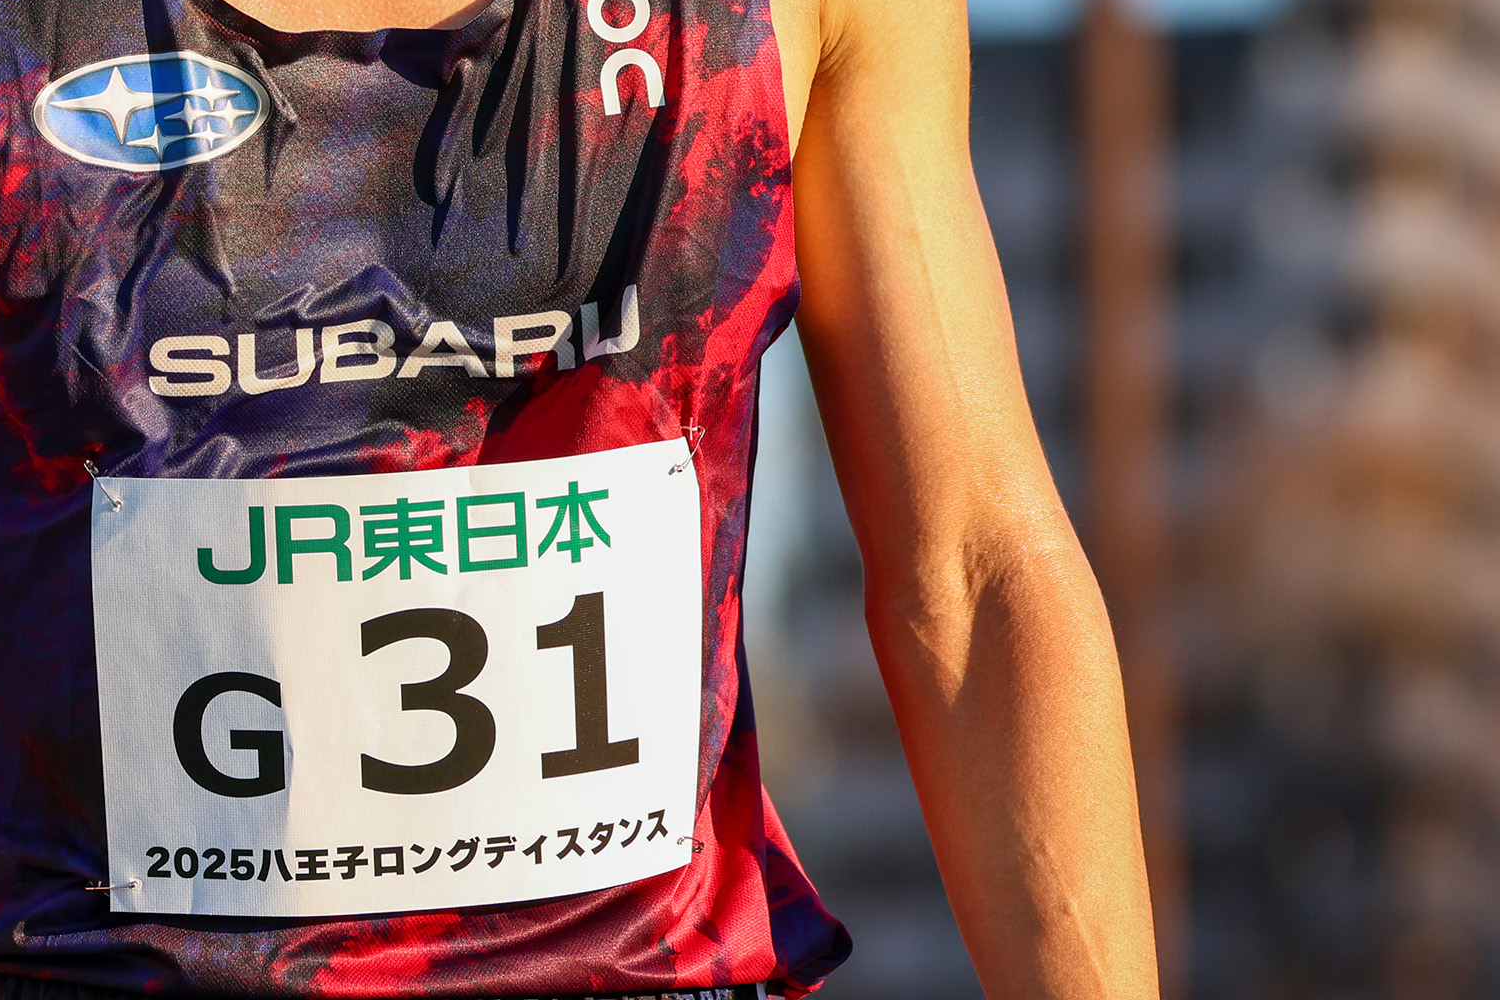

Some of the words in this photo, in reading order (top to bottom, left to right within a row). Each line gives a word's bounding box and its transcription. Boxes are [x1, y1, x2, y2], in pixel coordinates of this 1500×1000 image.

[149, 284, 640, 397] SUBARU
[197, 481, 612, 585] JR東日本
[172, 671, 288, 799] G
[360, 591, 640, 795] 31
[145, 808, 669, 884] 2025八王子ロングディスタンス
